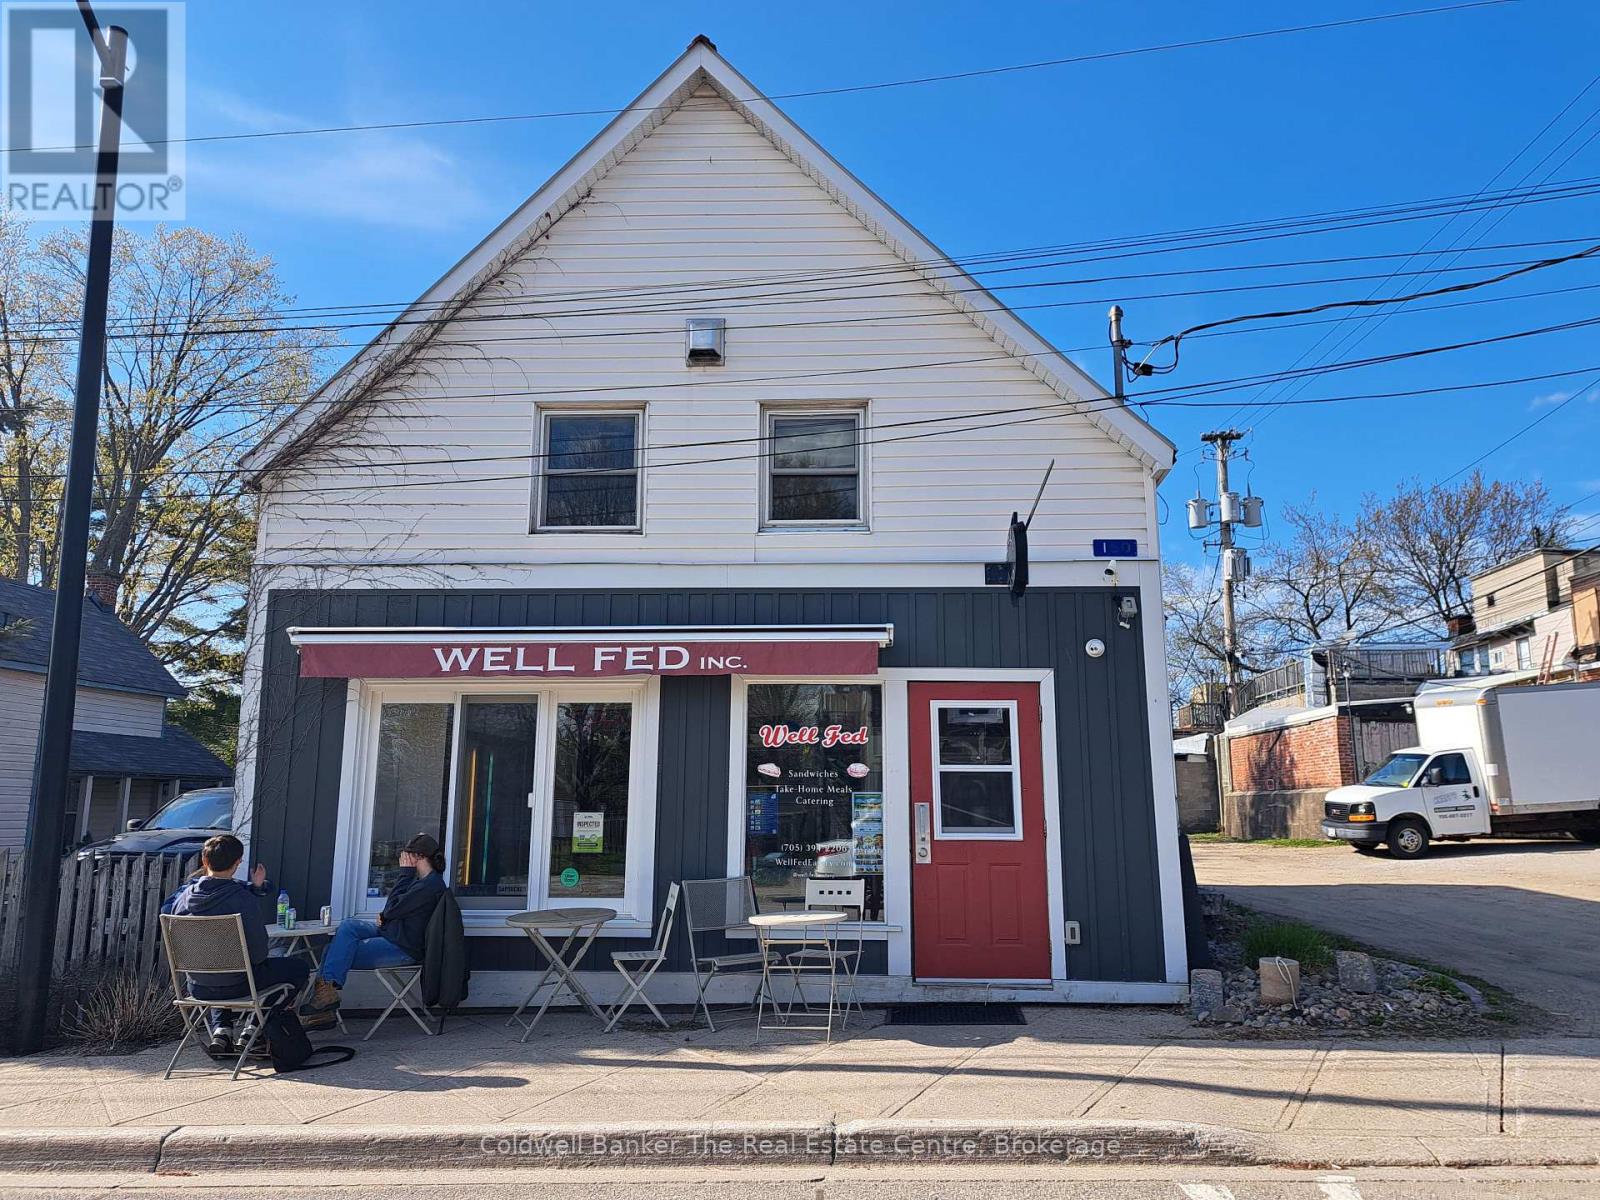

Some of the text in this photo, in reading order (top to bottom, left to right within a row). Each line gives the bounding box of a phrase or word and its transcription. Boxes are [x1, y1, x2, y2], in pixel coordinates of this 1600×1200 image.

[433, 646, 748, 672] WELL FED INC.
[759, 724, 869, 748] Well Fed
[788, 769, 839, 778] Sandwiches
[775, 784, 853, 793] Take-Home Meals
[795, 796, 835, 807] Catering
[781, 843, 803, 852] (705)
